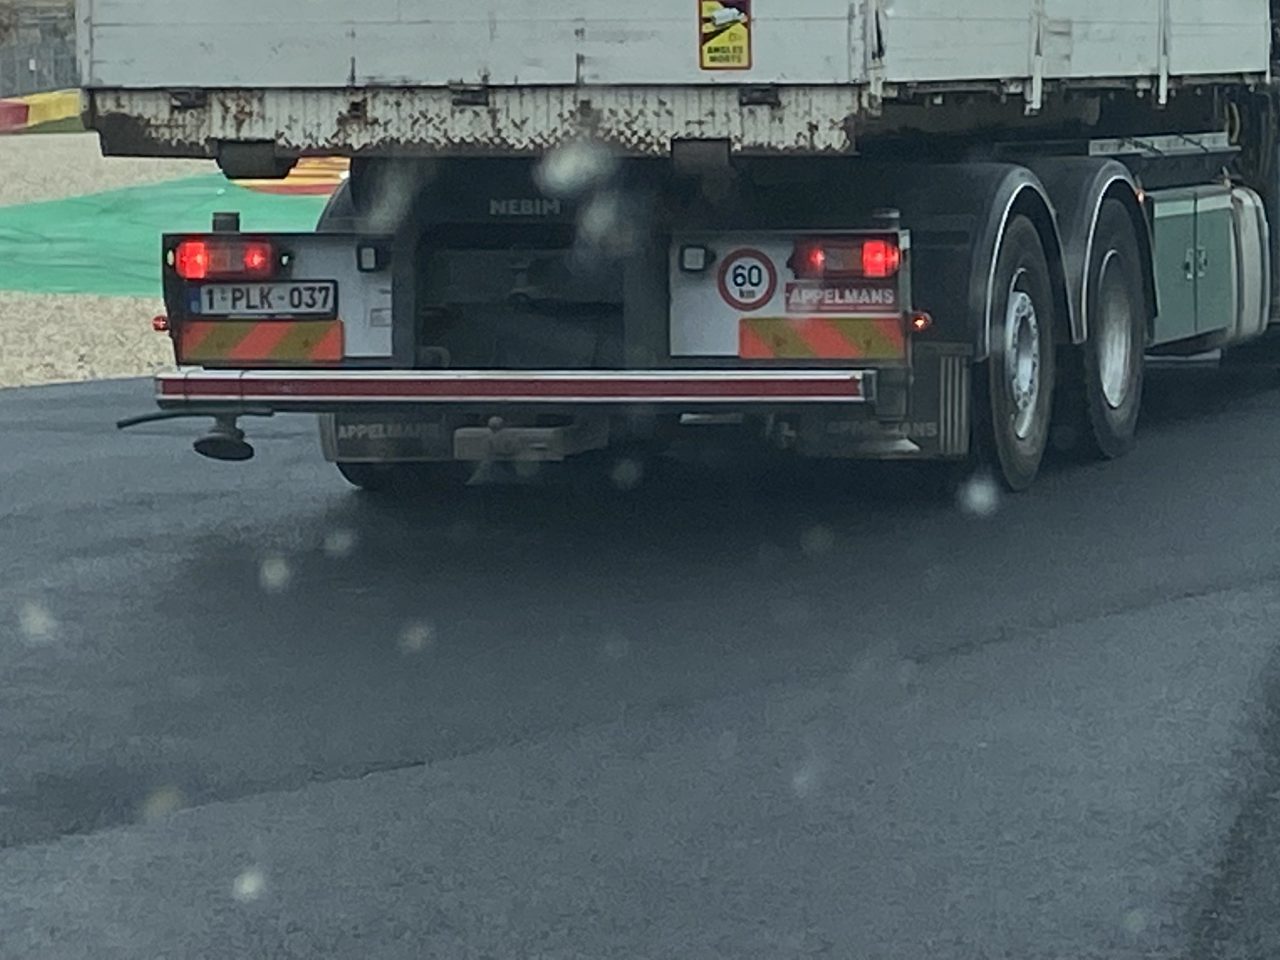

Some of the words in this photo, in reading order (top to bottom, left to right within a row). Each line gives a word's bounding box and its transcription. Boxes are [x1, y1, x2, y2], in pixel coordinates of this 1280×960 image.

[490, 199, 561, 215] NEBIM
[732, 264, 763, 287] 60
[789, 289, 895, 305] APPELMANS
